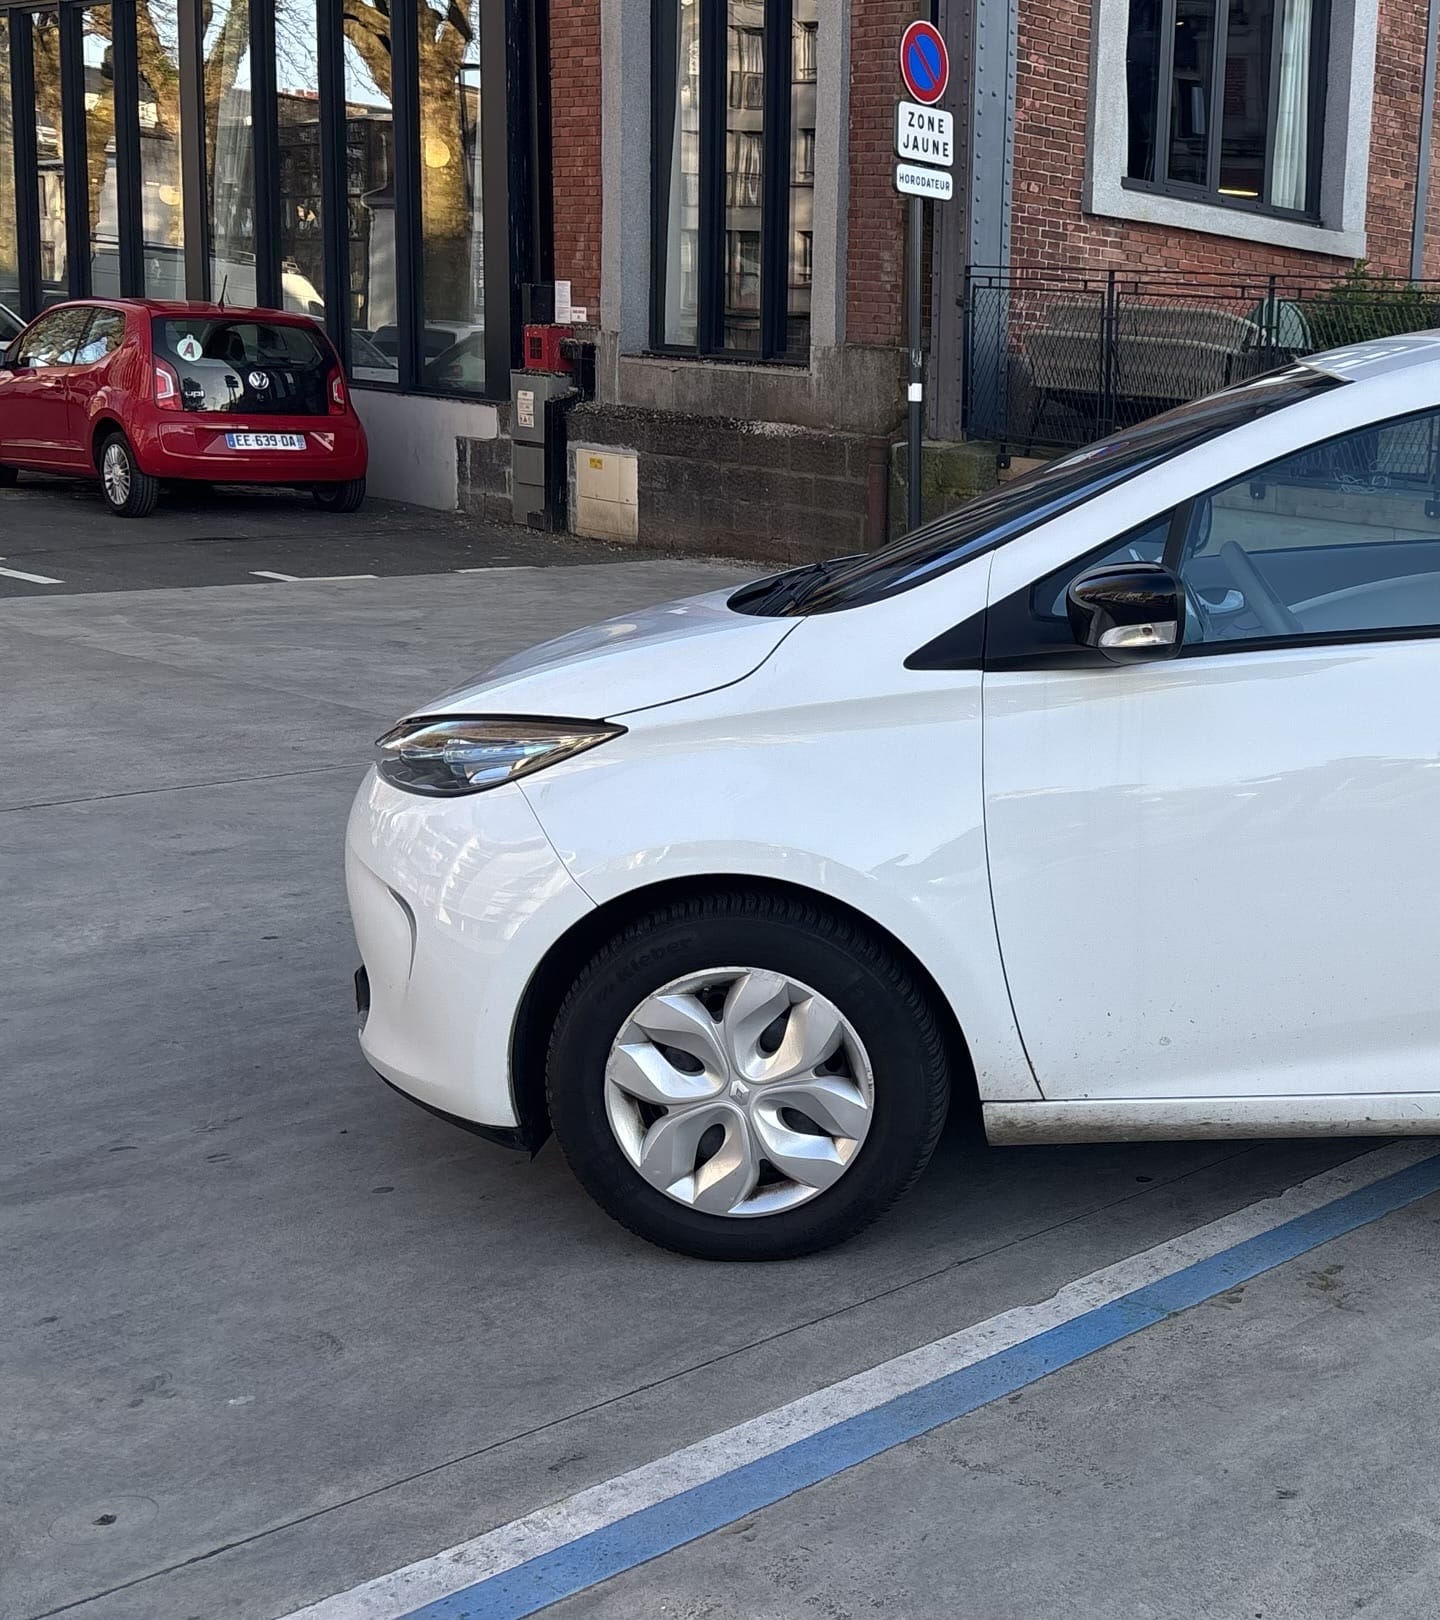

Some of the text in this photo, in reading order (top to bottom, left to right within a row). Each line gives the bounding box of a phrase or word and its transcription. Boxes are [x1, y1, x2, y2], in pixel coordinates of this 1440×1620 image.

[908, 111, 944, 134] ZONE
[903, 133, 949, 157] JAUNE
[899, 173, 950, 191] HORODATEUR
[183, 341, 196, 359] A
